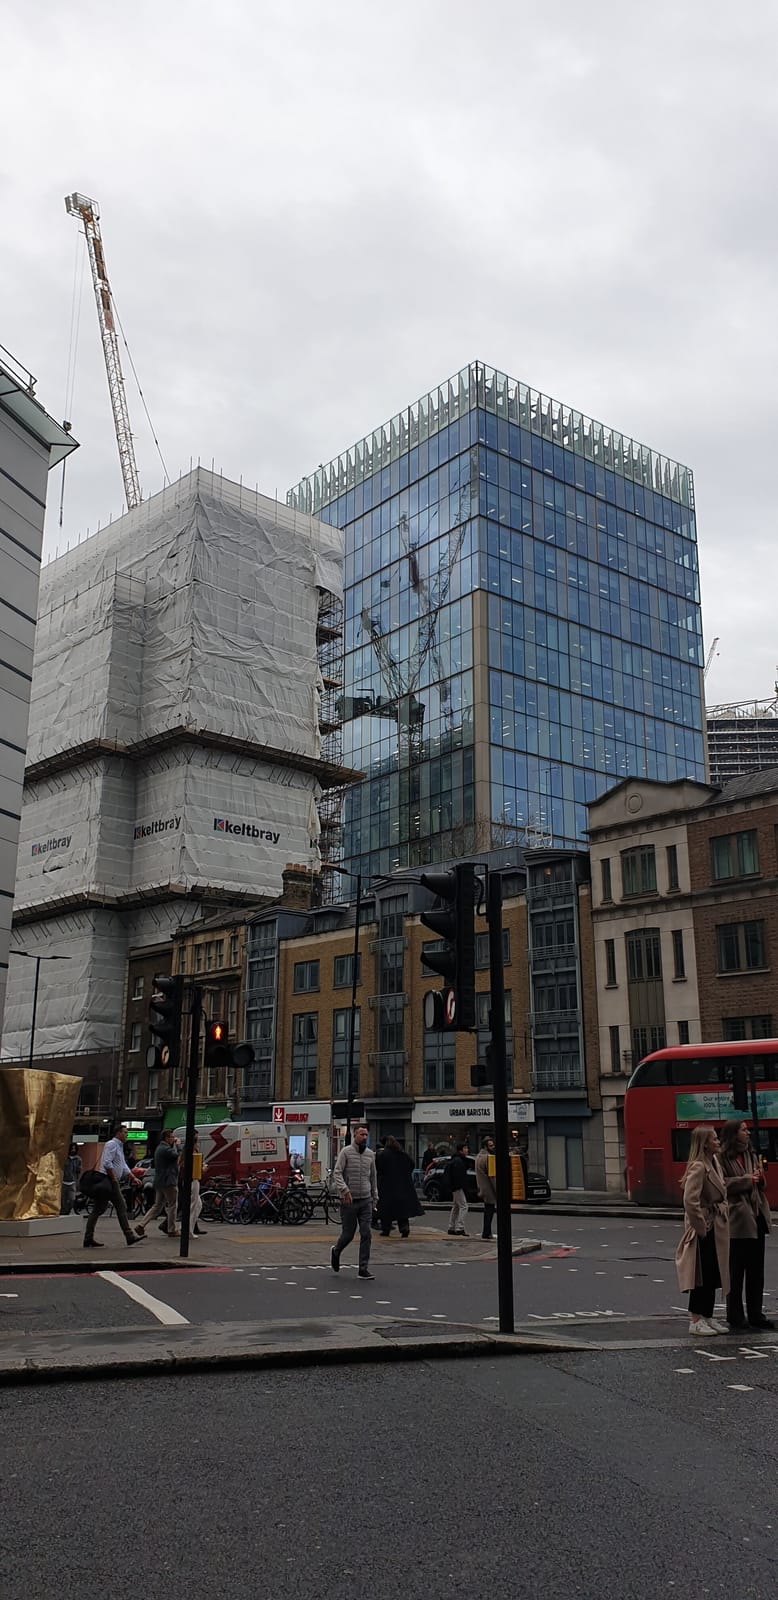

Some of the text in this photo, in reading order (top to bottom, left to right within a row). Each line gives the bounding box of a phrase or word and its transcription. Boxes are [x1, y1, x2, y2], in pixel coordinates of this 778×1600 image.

[140, 815, 182, 838] keltbray
[225, 822, 281, 845] keltbray
[38, 835, 73, 854] keltbray
[449, 1108, 466, 1117] URBAN
[467, 1108, 491, 1117] BARISTAS
[528, 1309, 626, 1321] LOOK
